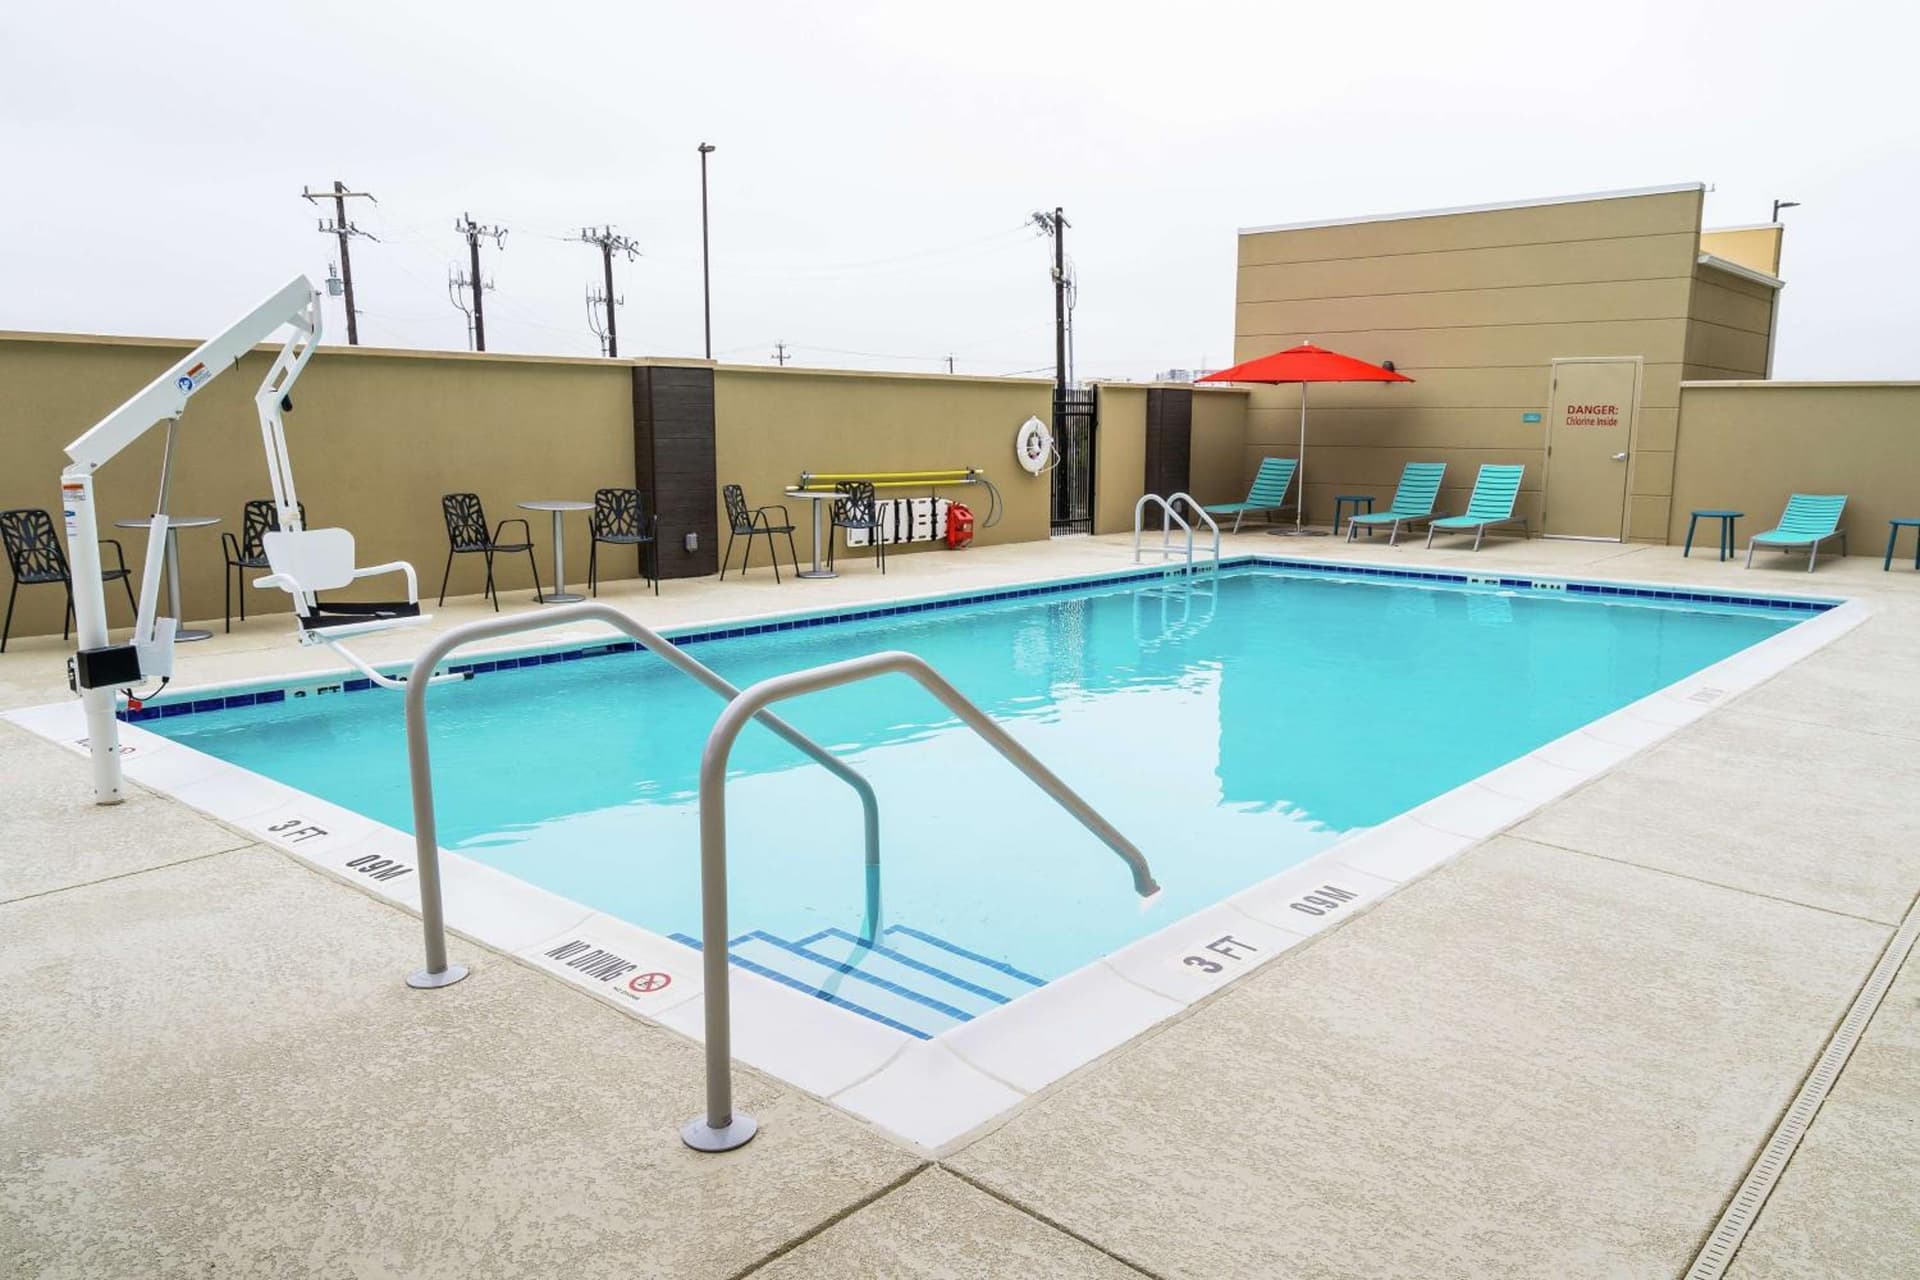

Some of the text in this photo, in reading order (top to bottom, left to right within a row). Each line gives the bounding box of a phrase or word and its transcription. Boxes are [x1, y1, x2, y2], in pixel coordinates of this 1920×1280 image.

[1566, 416, 1618, 426] Chlorine Inside
[1567, 405, 1619, 415] DANGER:
[268, 819, 328, 843] 3 FT
[544, 939, 638, 983] NO DIVING
[1183, 935, 1258, 974] 3 FT
